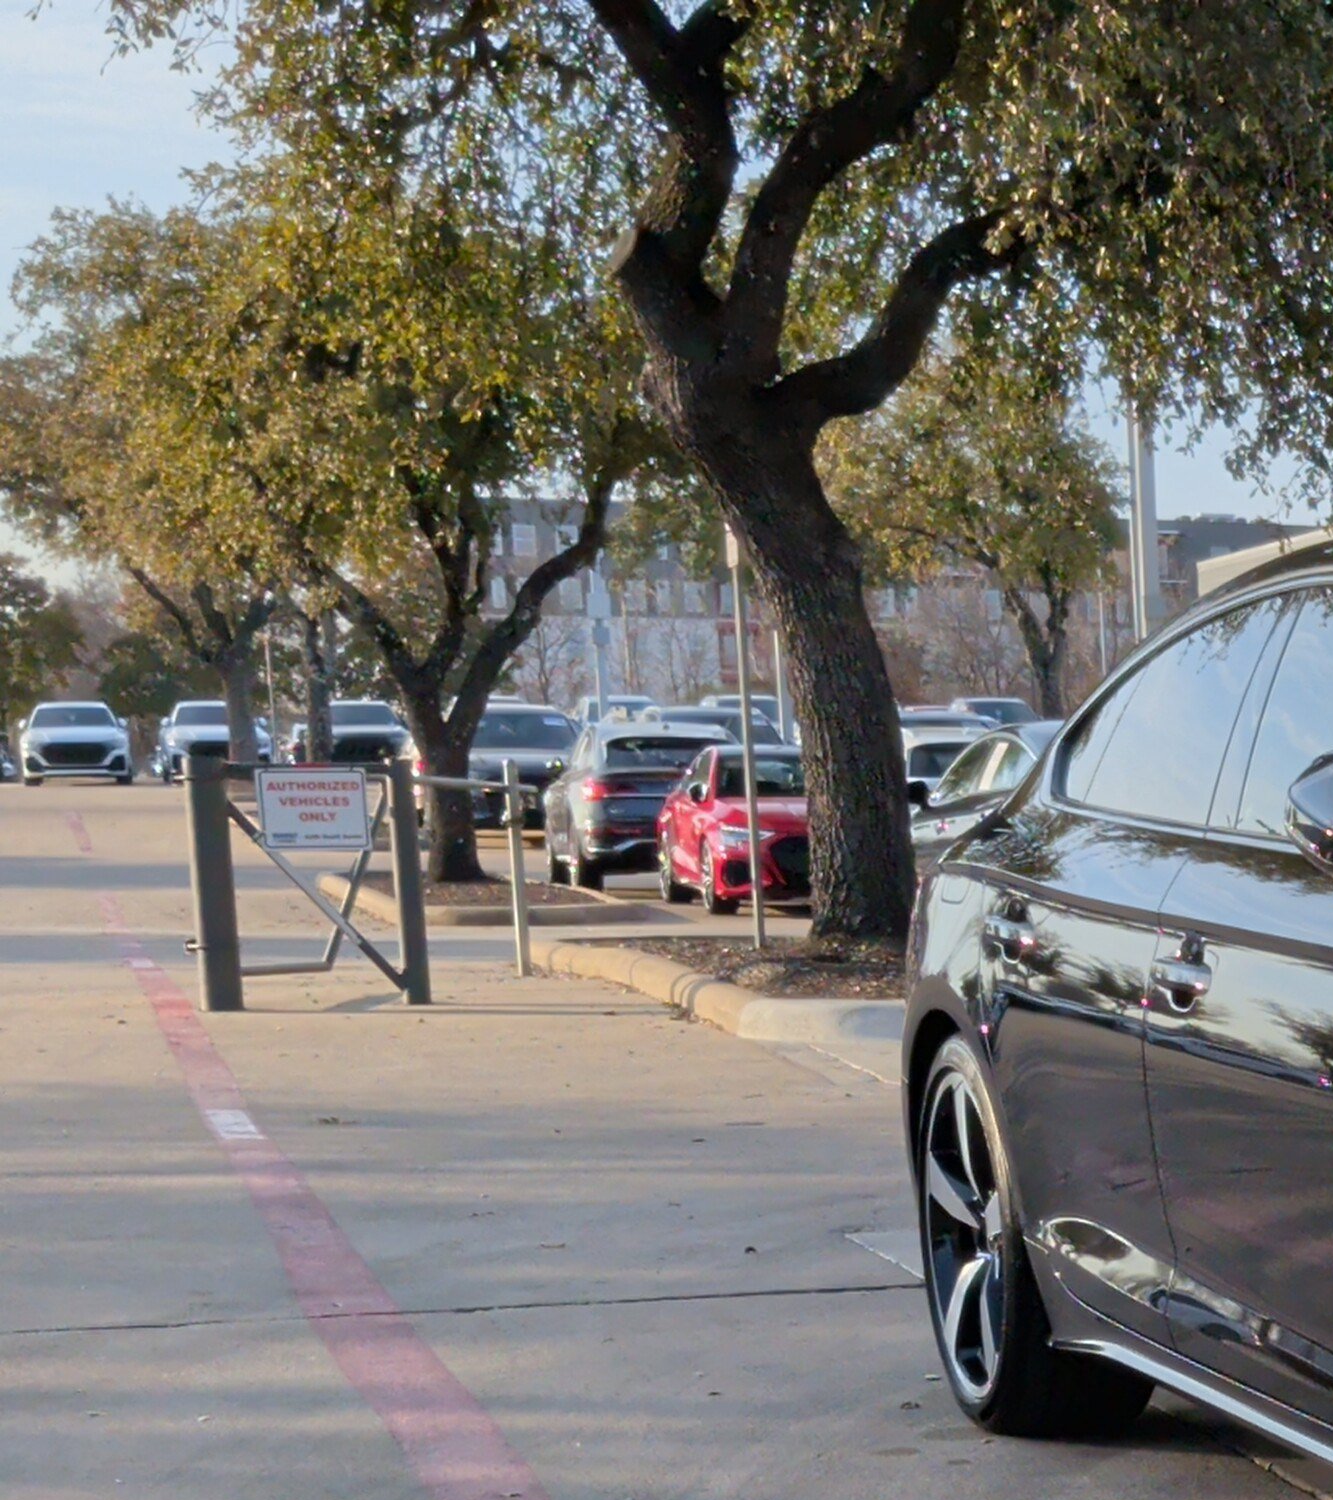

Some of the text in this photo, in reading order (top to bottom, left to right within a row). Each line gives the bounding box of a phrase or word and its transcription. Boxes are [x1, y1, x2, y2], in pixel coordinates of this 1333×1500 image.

[266, 781, 360, 791] AUTHORIZED
[279, 797, 350, 806] VEHICLES
[299, 812, 336, 822] ONLY
